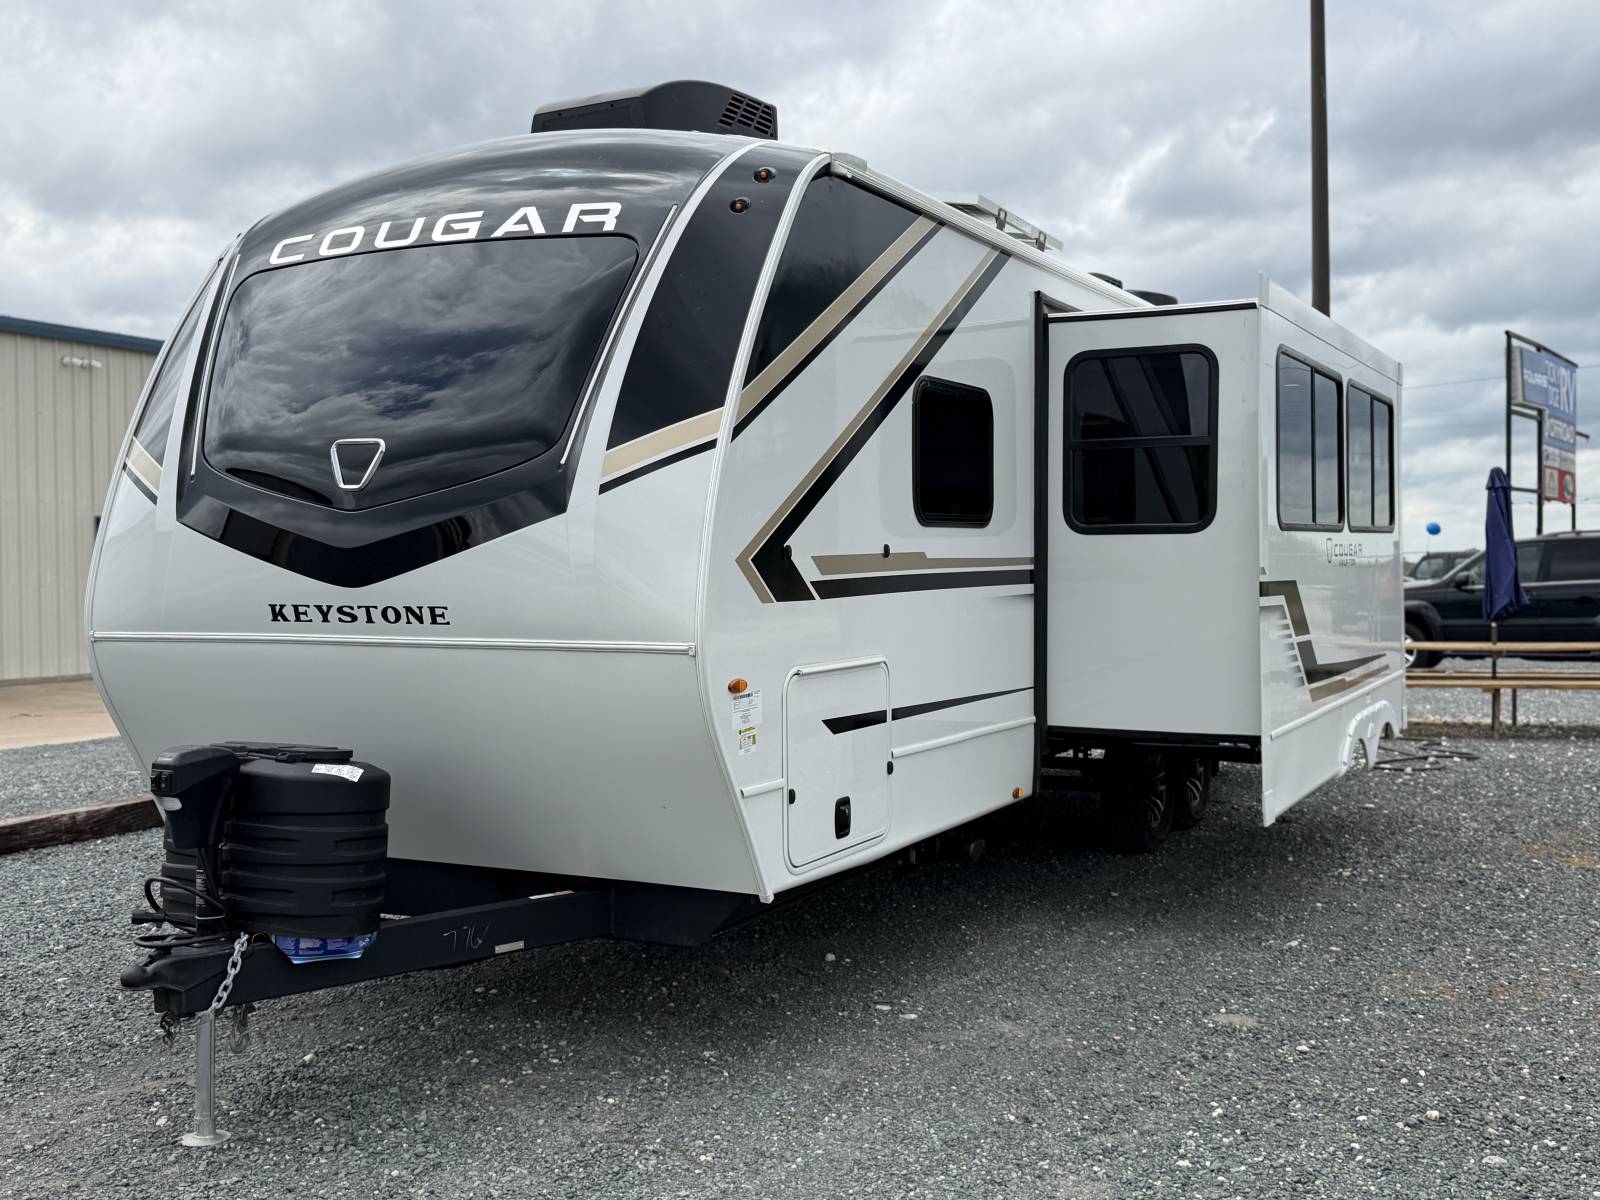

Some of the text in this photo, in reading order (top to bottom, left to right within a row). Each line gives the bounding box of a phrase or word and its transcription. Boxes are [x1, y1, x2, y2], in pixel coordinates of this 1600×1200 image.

[269, 201, 622, 265] COUGAR
[1334, 543, 1363, 557] COUGAR
[268, 603, 451, 625] KEYSTONE
